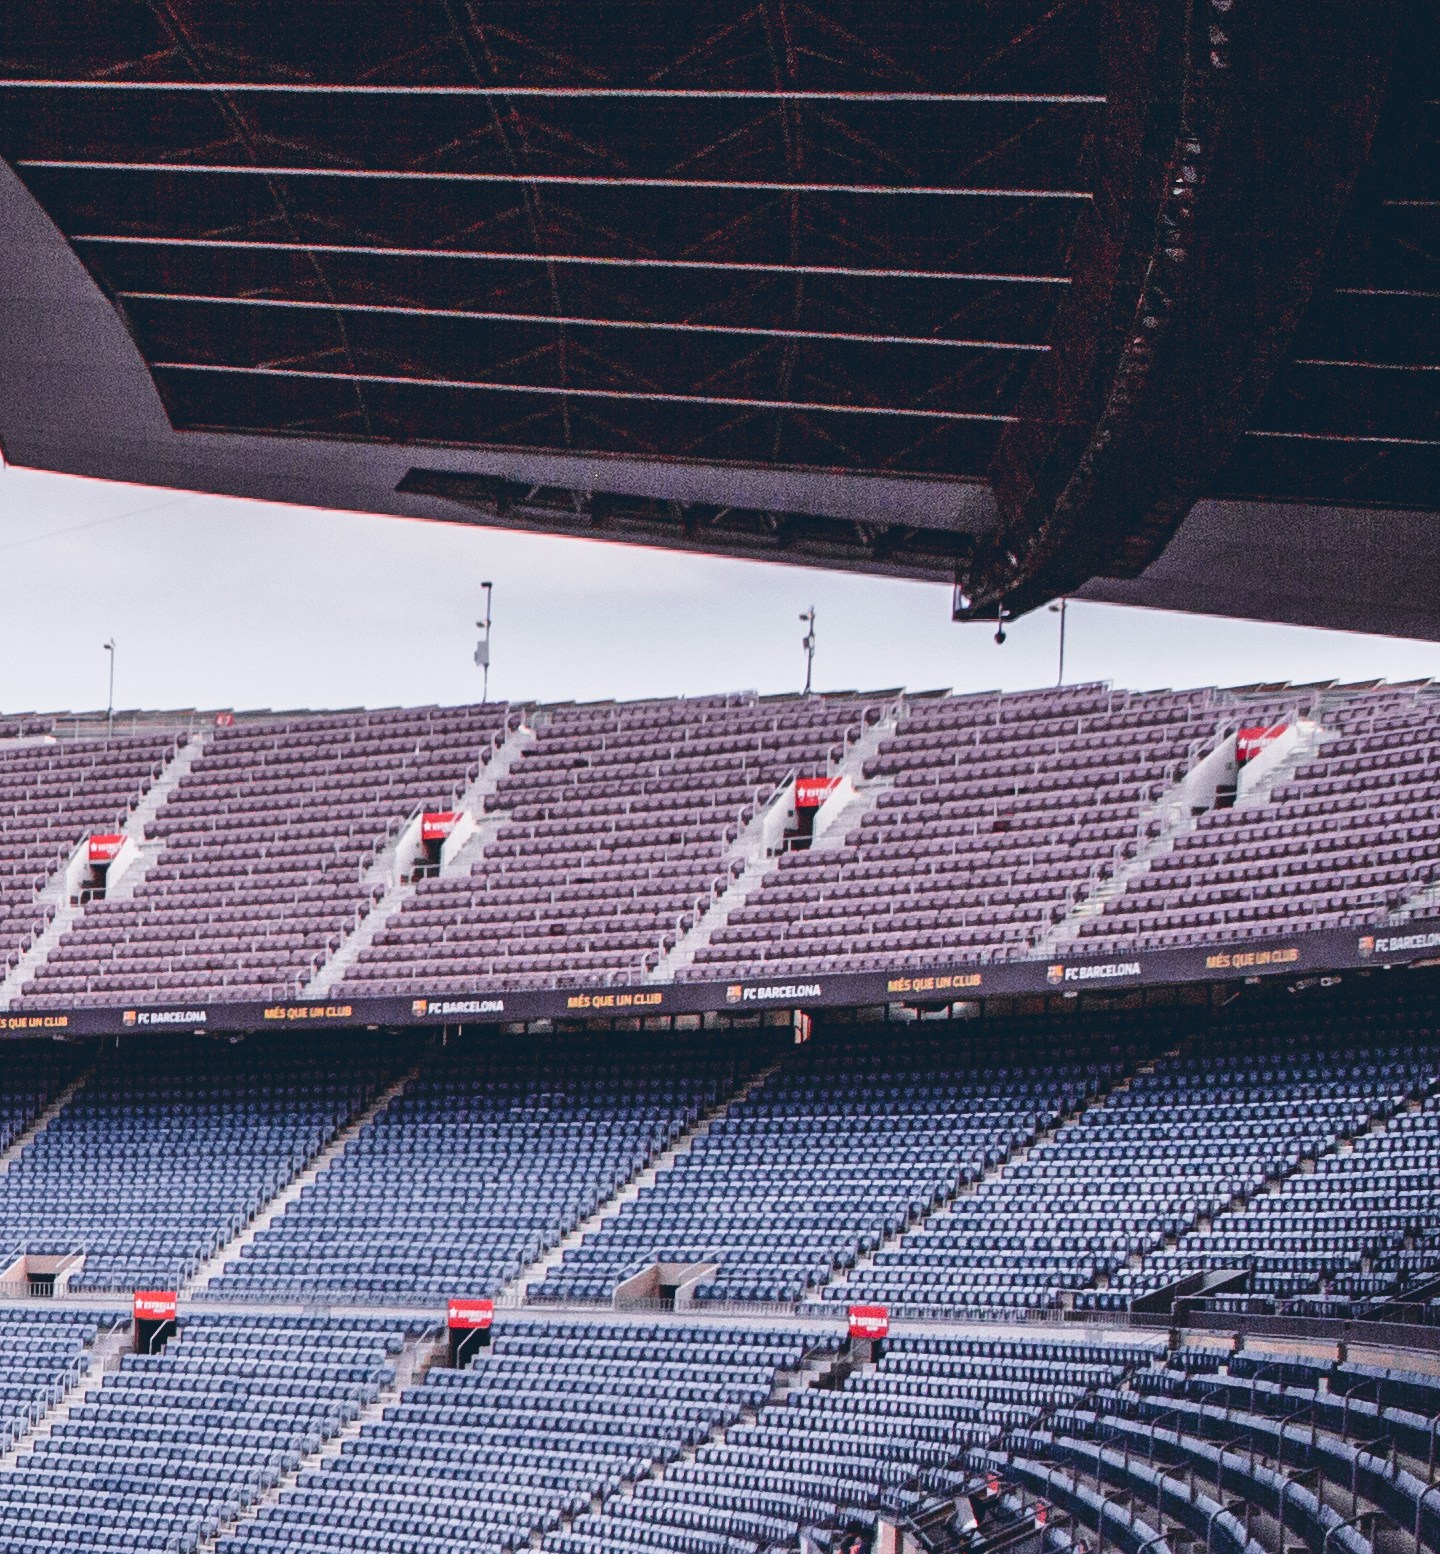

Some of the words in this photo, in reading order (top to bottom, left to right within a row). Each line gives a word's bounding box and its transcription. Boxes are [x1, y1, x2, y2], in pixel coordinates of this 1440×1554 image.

[1375, 938, 1387, 951] FC
[1389, 933, 1440, 951] BARCELON
[1064, 967, 1076, 980] FC
[1078, 963, 1140, 979] BARCELONA
[889, 978, 912, 991] MÉS
[914, 978, 934, 990] QUE
[955, 974, 981, 987] CLUB
[743, 988, 755, 1000] FC
[758, 984, 821, 999] BARCELONA
[428, 1003, 440, 1014] FC
[442, 1000, 503, 1013] BARCELONA
[568, 996, 591, 1008] MÉS
[593, 996, 614, 1007] QUE
[636, 993, 662, 1004] CLUB
[138, 1013, 149, 1024] FC
[151, 1011, 206, 1023] BARCELONA
[265, 1008, 286, 1019] MÉS
[288, 1008, 308, 1019] QUE
[328, 1005, 352, 1016] CLUB
[8, 1018, 26, 1028] QUE
[45, 1016, 67, 1027] CLUB
